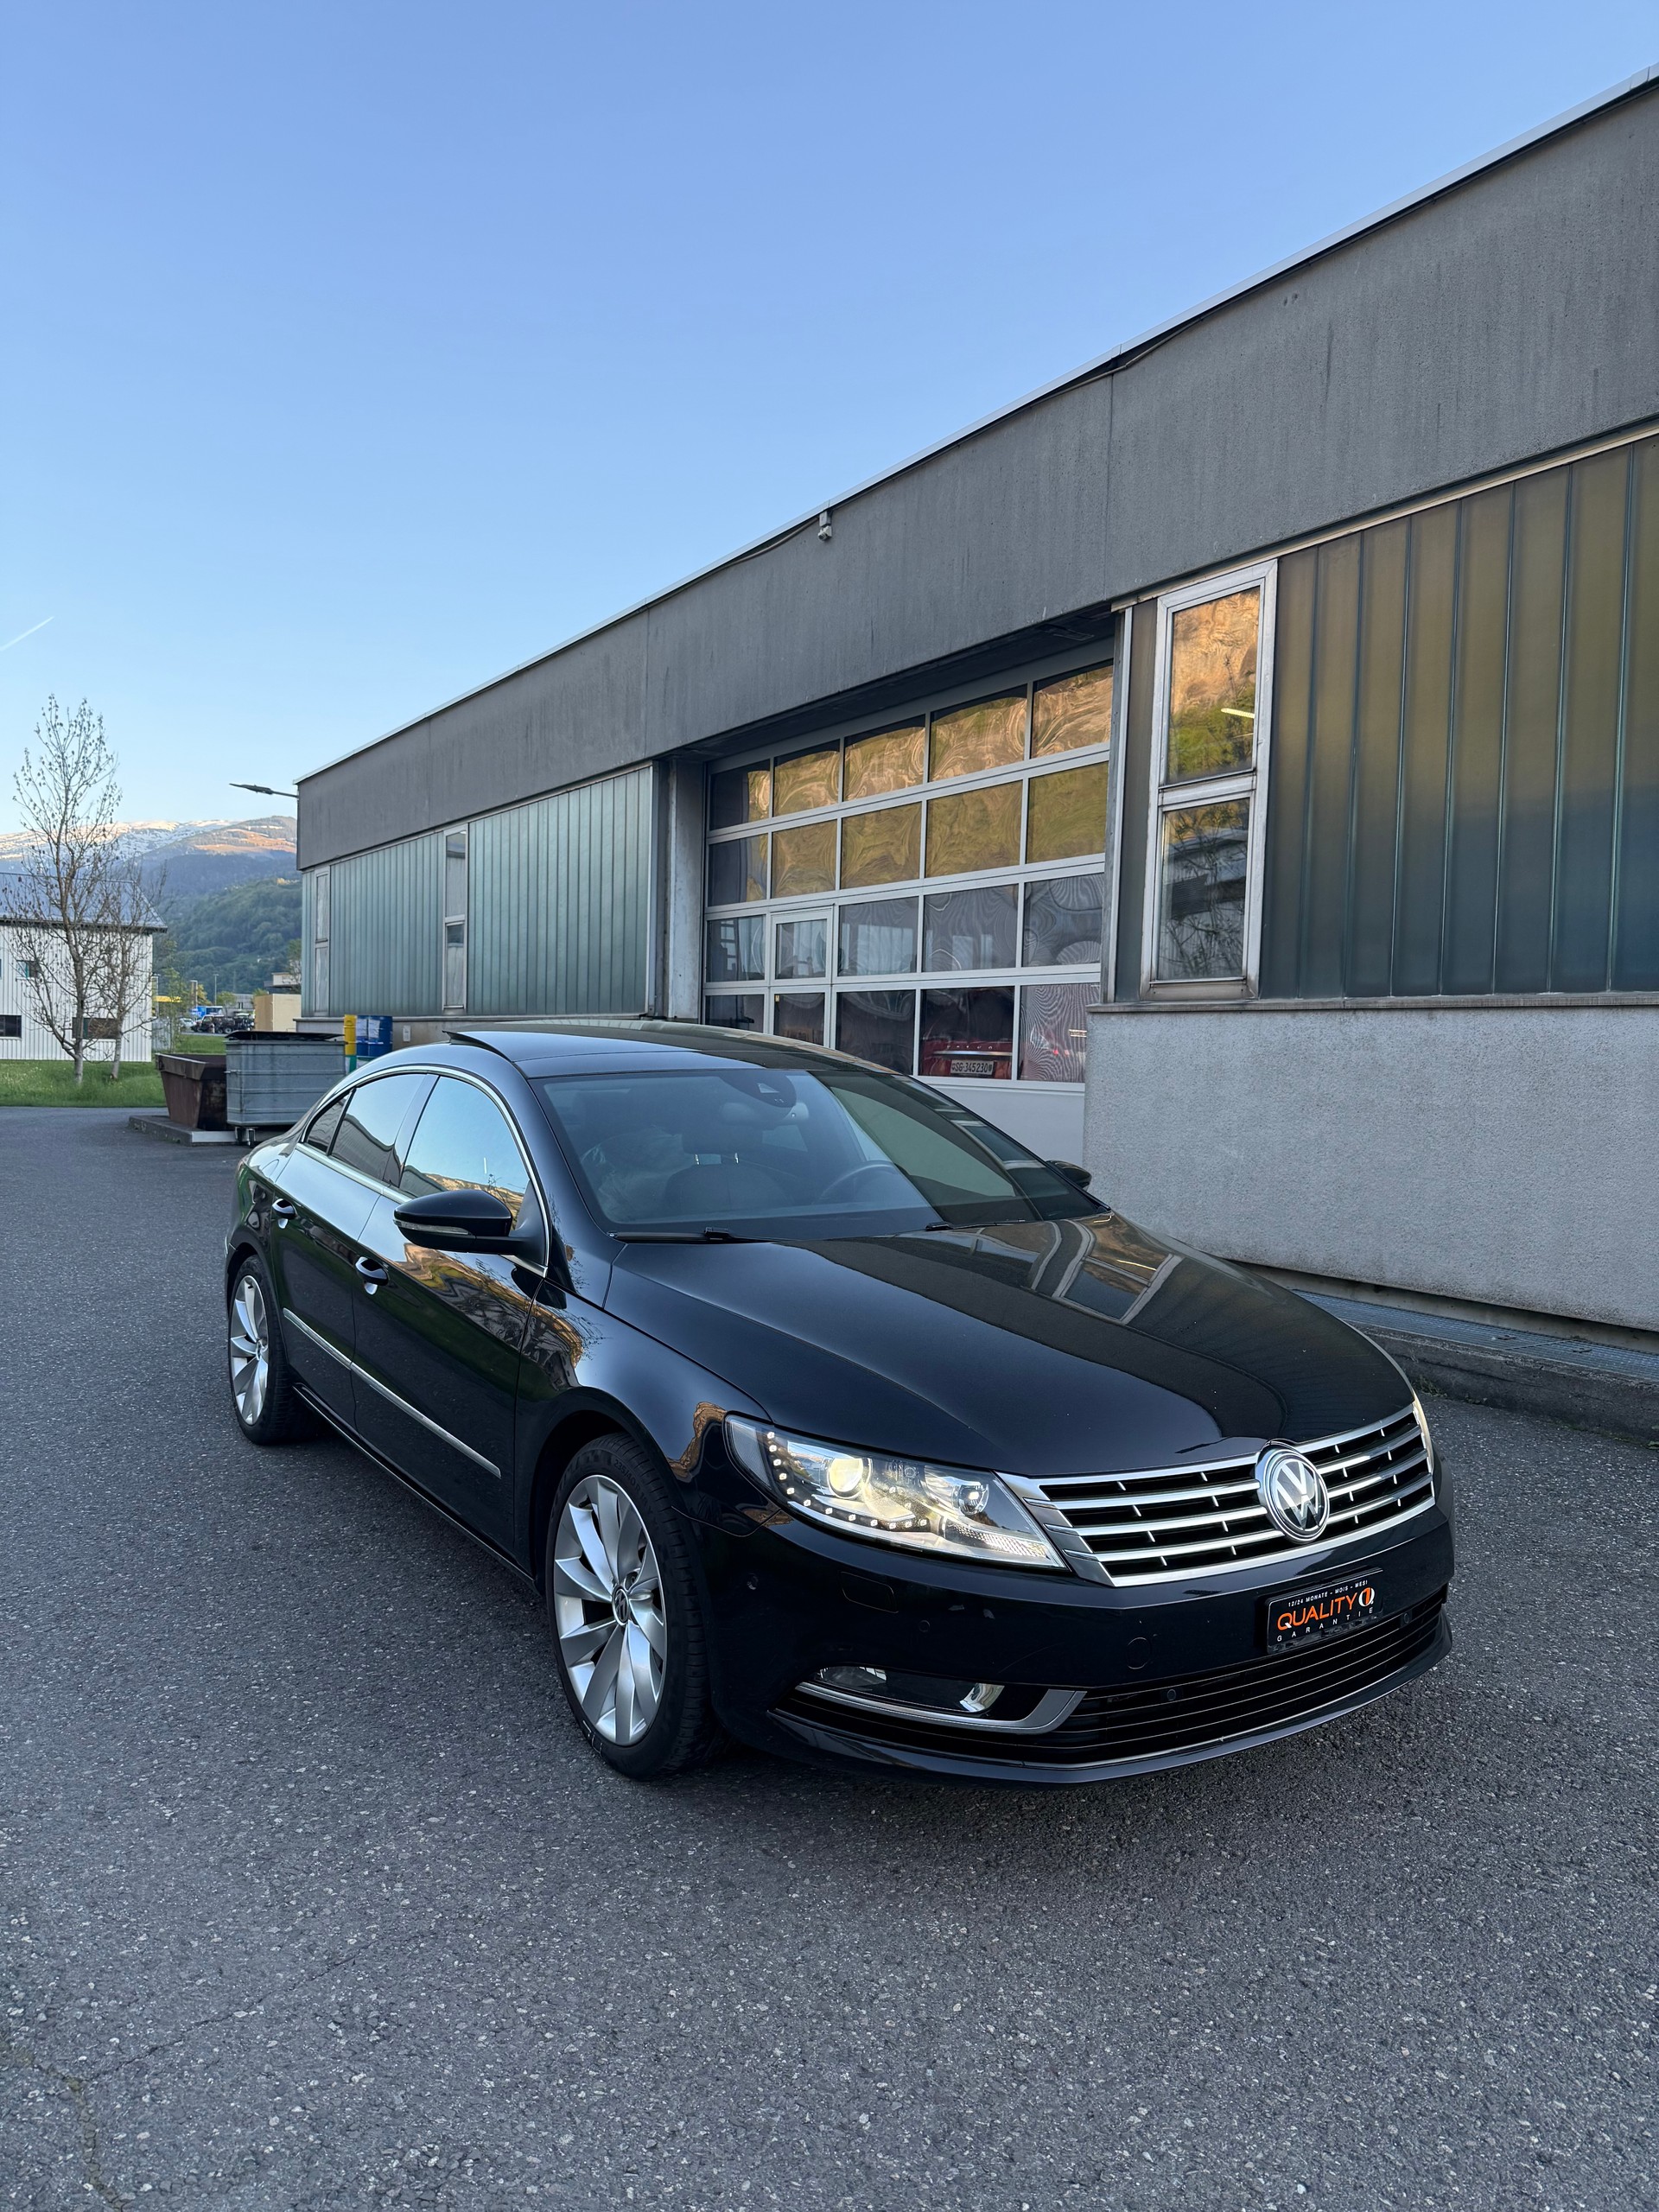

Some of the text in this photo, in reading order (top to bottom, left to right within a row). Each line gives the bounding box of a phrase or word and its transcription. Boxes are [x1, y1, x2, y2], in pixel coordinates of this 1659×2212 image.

[1270, 1456, 1324, 1534] VW
[1277, 1592, 1358, 1630] QUALITY
[1287, 1599, 1304, 1607] 12/24
[1306, 1591, 1328, 1603] MONATE
[1335, 1586, 1349, 1594] MOIS
[1355, 1580, 1368, 1588] MESI
[1276, 1606, 1374, 1642] GARANTIE
